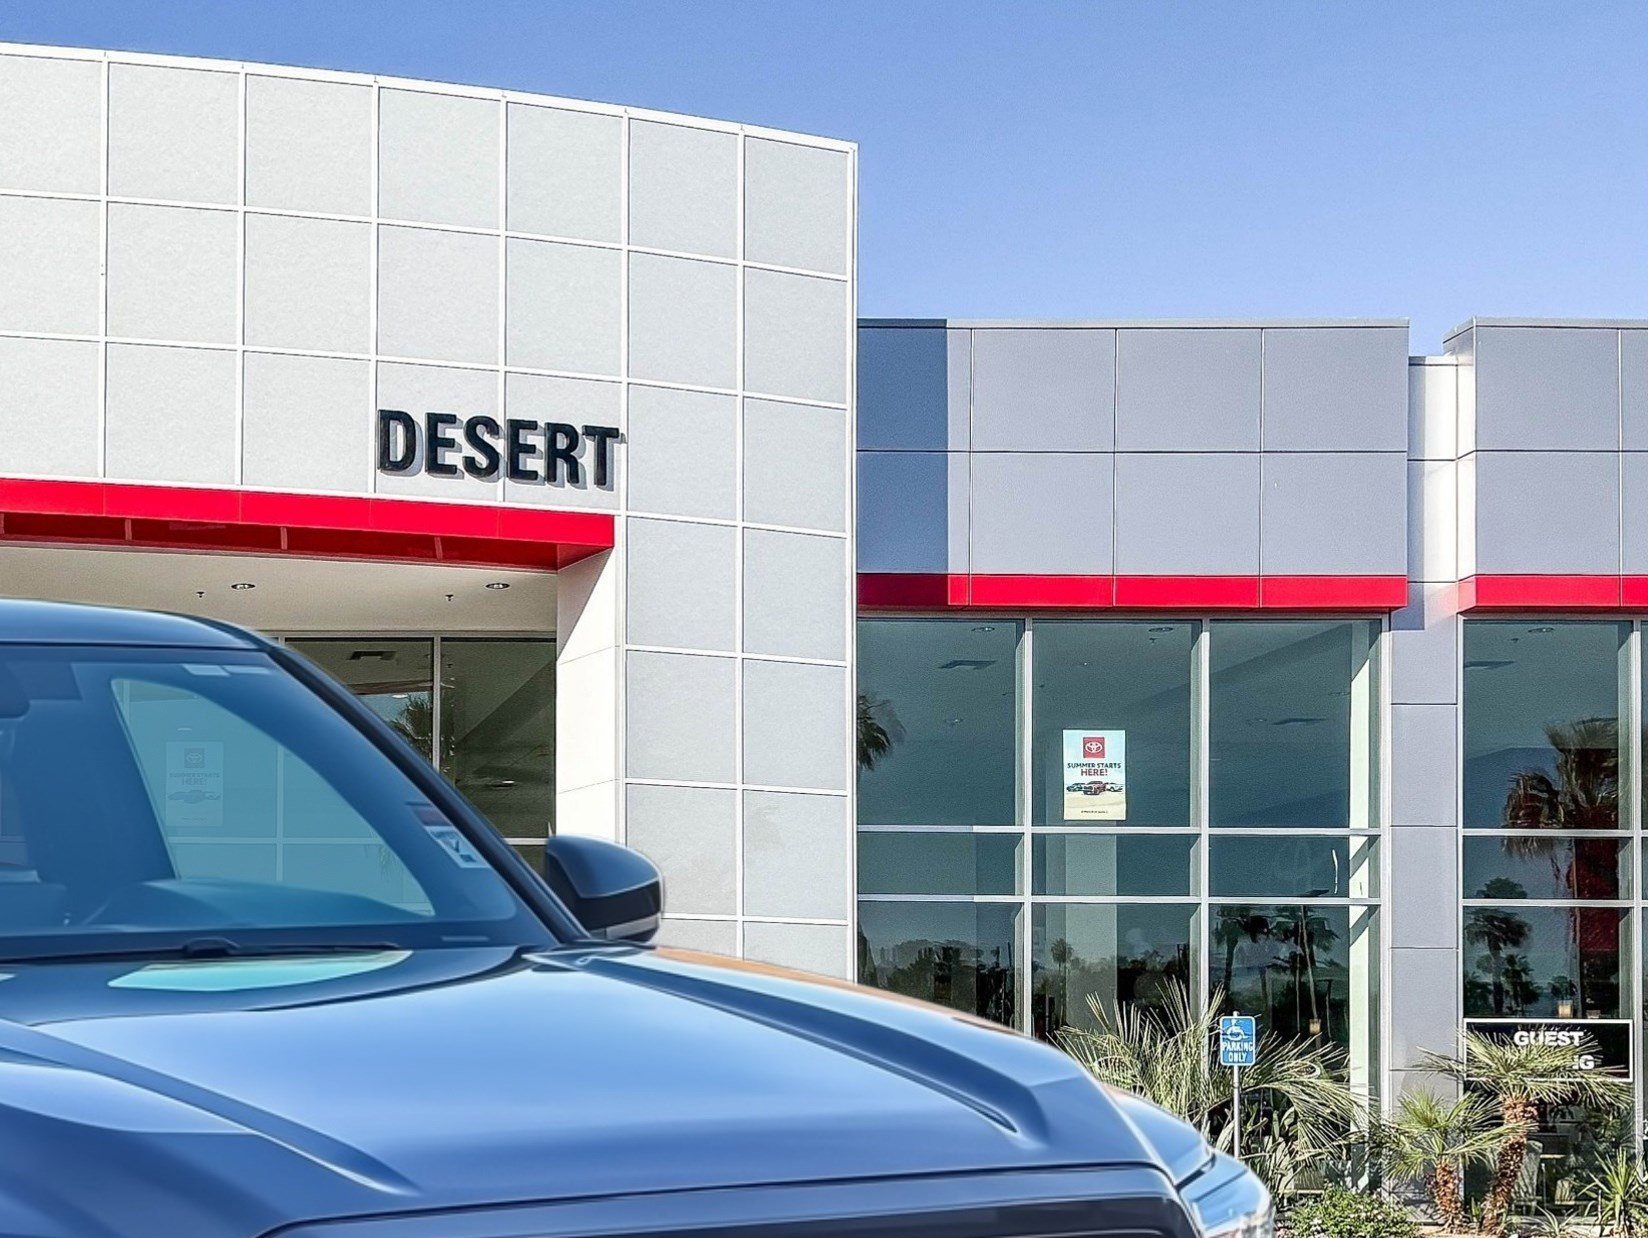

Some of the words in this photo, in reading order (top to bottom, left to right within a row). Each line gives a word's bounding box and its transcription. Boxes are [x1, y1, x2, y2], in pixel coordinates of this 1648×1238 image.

[377, 409, 620, 486] DESERT
[1080, 769, 1108, 777] HERE!
[1514, 1030, 1584, 1047] GUEST
[1222, 1042, 1253, 1052] PARKING
[1228, 1052, 1248, 1062] ONLY
